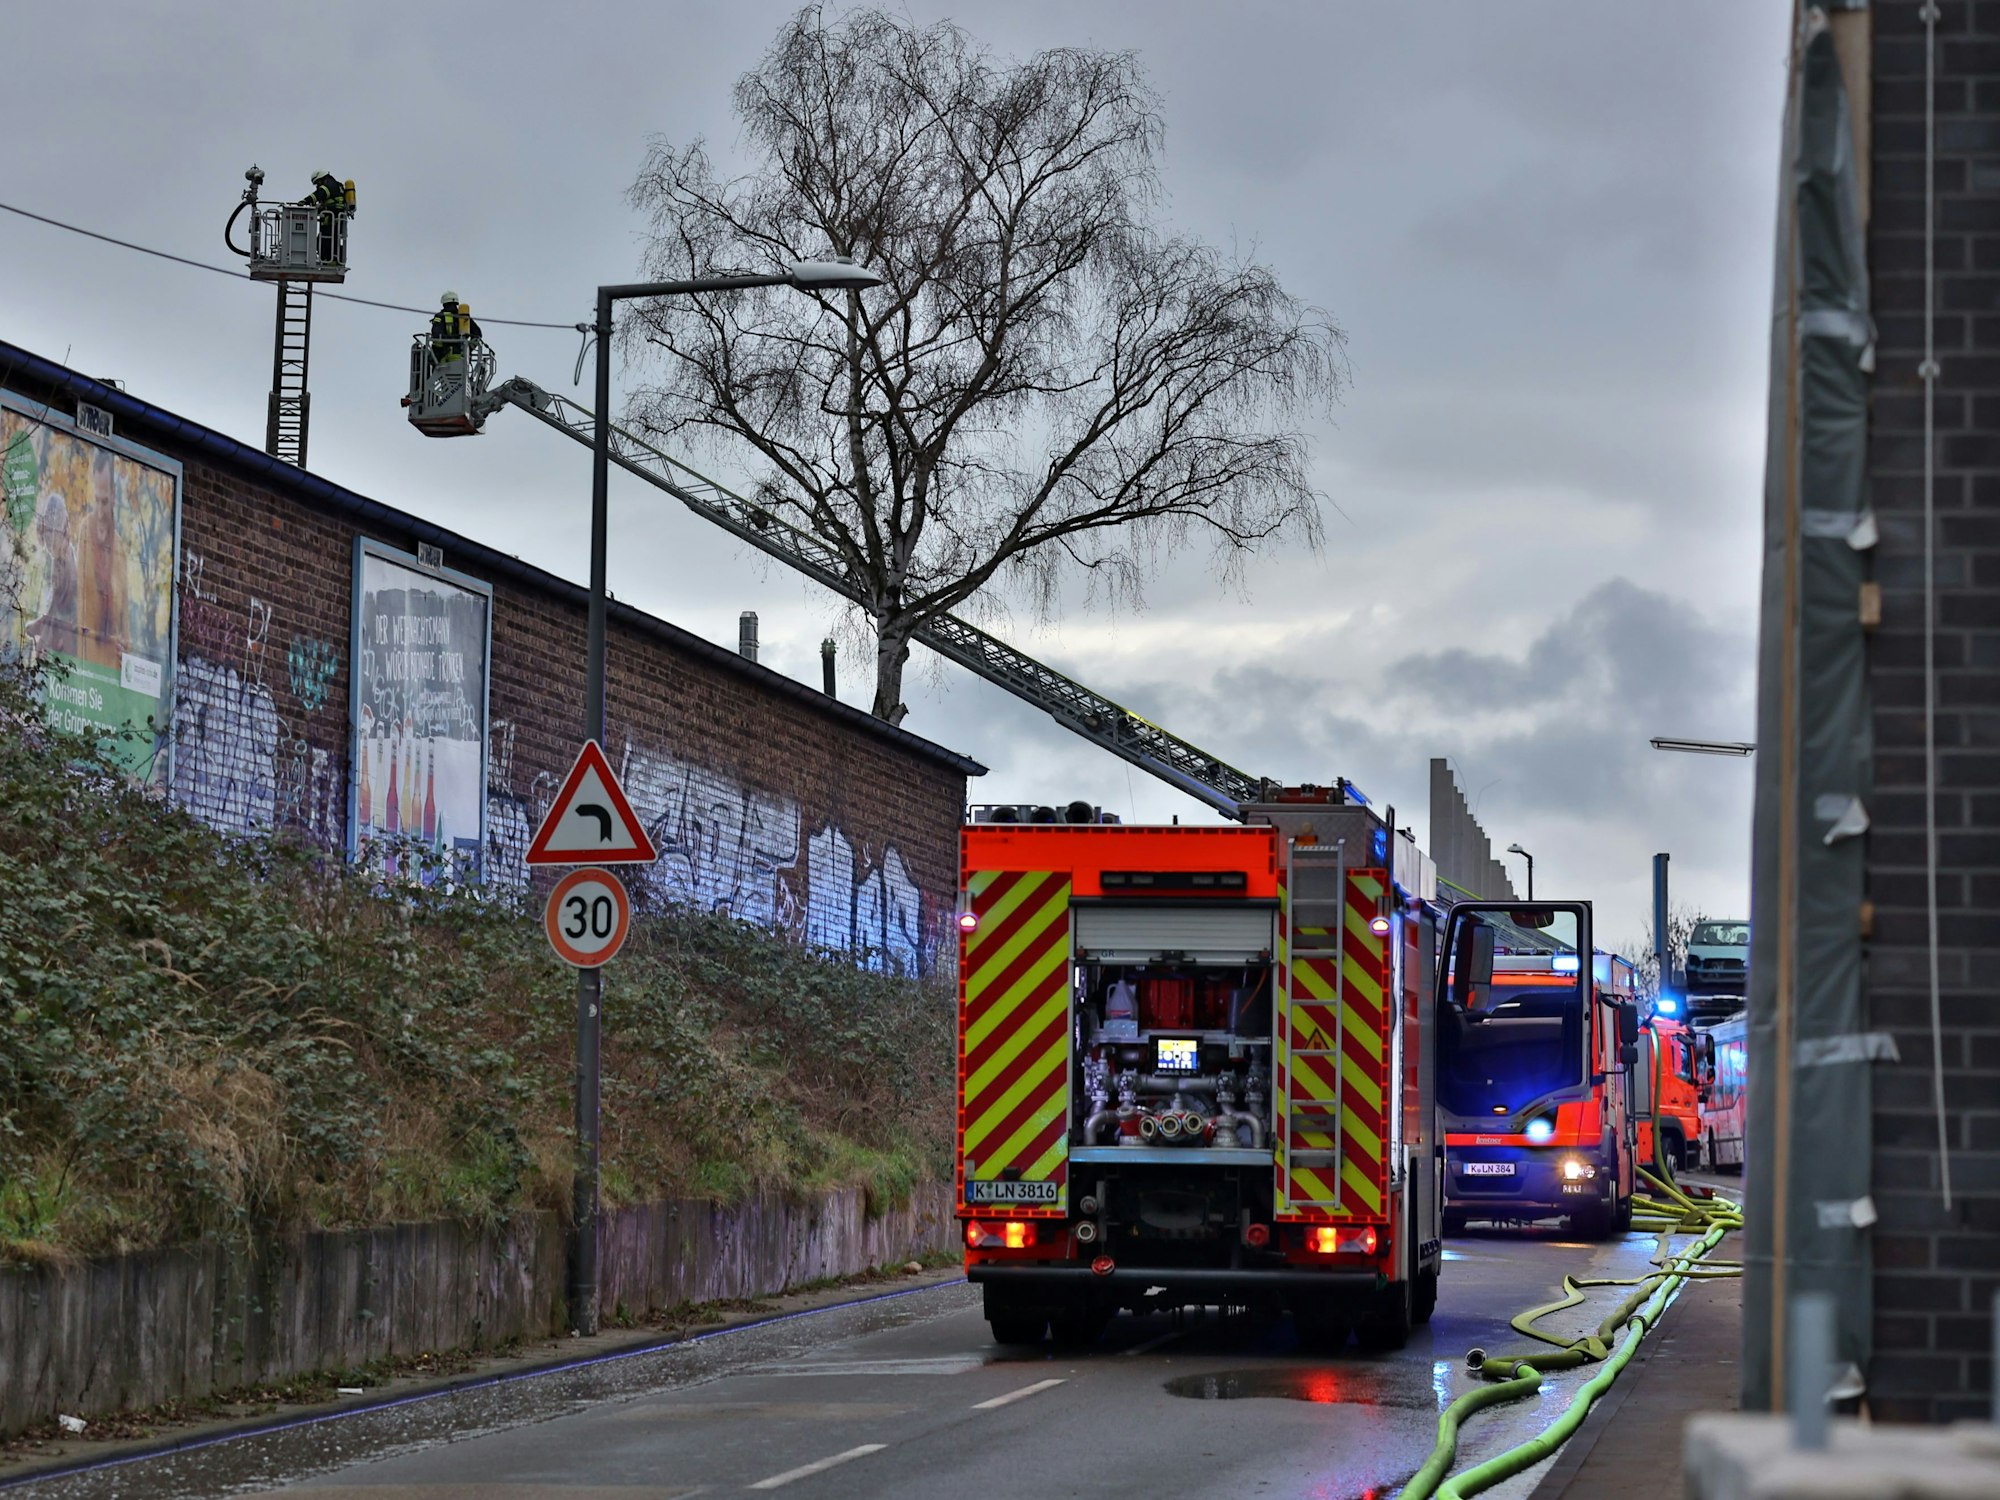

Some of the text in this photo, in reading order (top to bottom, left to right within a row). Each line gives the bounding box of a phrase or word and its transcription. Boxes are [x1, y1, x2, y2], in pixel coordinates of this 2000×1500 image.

[437, 382, 463, 408] MAGIRUS
[375, 614, 389, 646] DER
[49, 676, 103, 711] Kommen Sie
[48, 703, 63, 729] der
[565, 896, 612, 938] 30
[1101, 950, 1115, 958] GR
[1471, 1165, 1511, 1173] K LN 384
[976, 1184, 1055, 1198] K LN 3816
